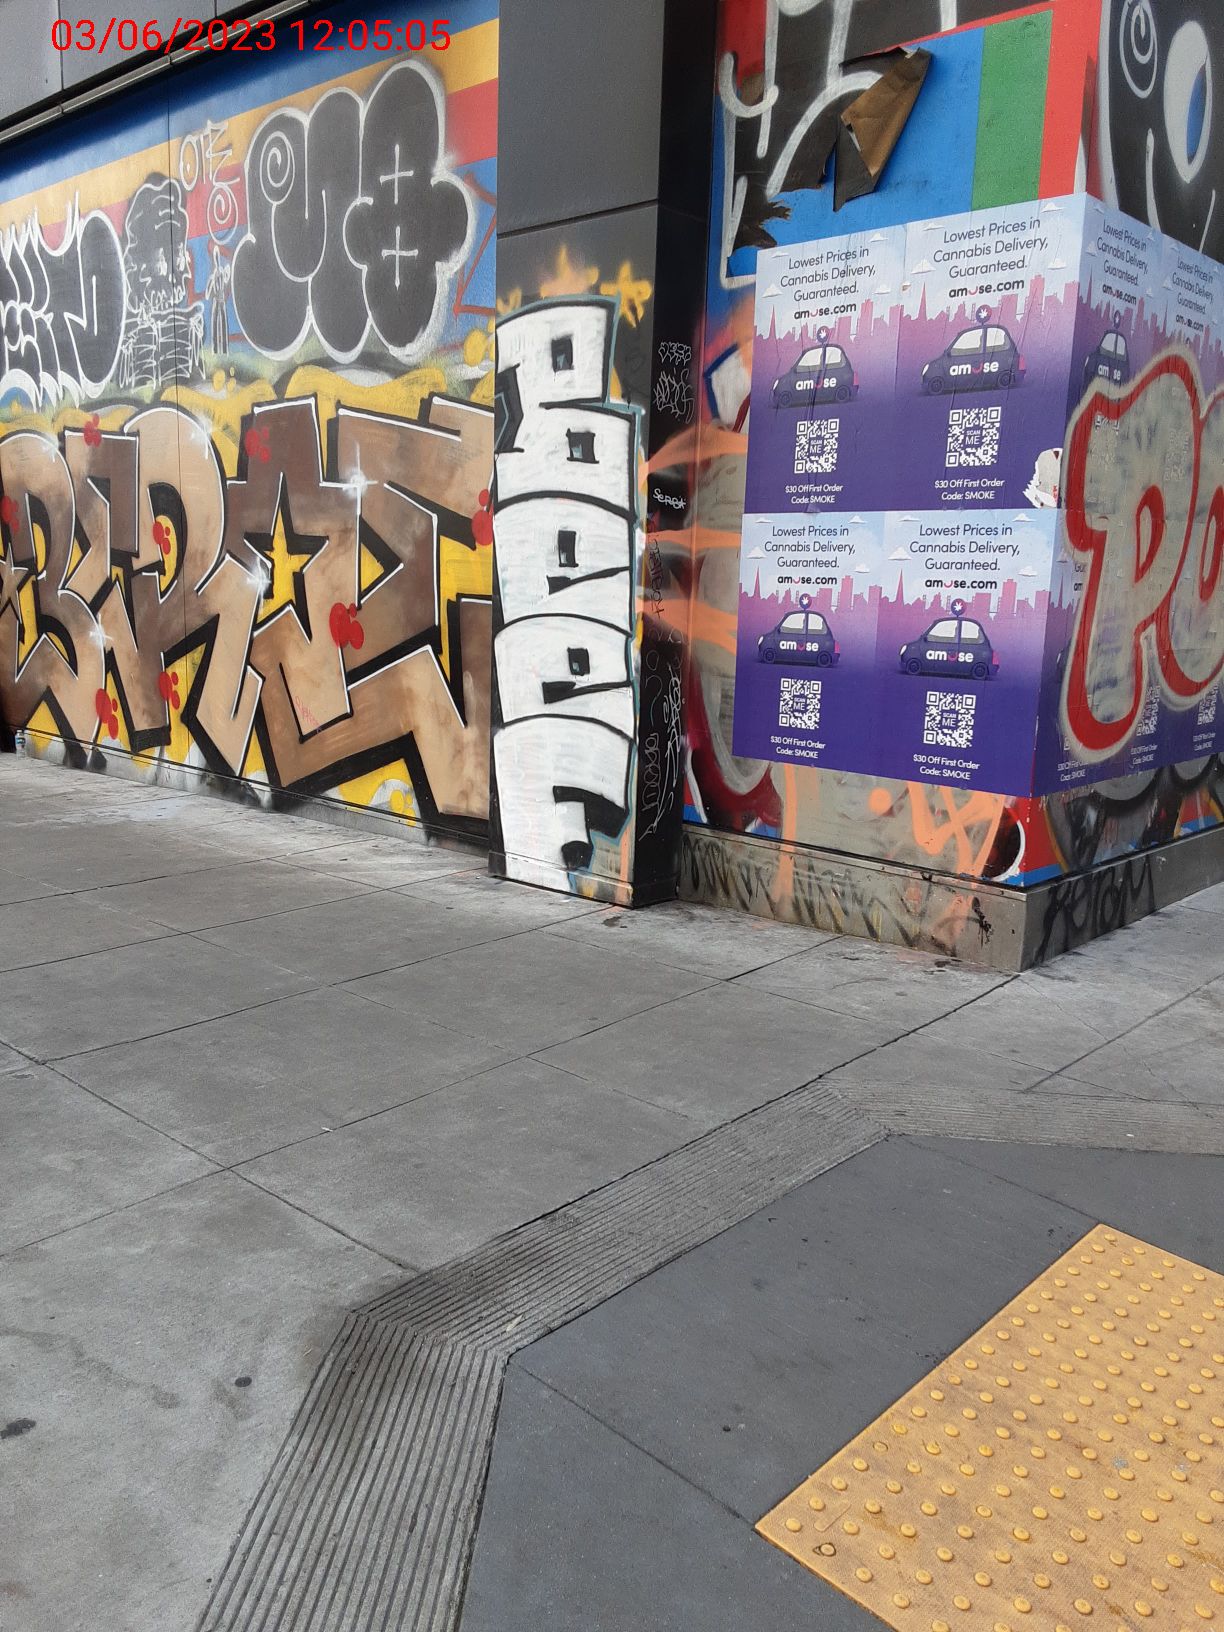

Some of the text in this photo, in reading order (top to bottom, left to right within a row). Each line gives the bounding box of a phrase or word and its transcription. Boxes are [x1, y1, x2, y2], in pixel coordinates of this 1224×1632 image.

[944, 217, 1040, 243] Lowest Prices in
[1104, 220, 1146, 251] Lowest Prices in
[934, 237, 1048, 262] Cannabis Delivery,
[1097, 237, 1125, 261] Cannabis
[789, 246, 869, 269] Lowest Prices in
[949, 255, 1027, 278] Guaranteed.
[781, 265, 875, 287] Cannabis Delivery,
[794, 281, 859, 301] Guaranteed.
[966, 436, 979, 445] ME
[810, 445, 821, 454] ME
[786, 484, 843, 493] $30 Off First Order
[935, 478, 1005, 488] $30 Off First Order
[810, 495, 835, 503] SMOKE
[965, 491, 995, 499] SMOKE
[773, 525, 848, 536] Lowest Prices in
[920, 524, 1012, 536] Lowest Prices in
[765, 541, 855, 555] Cannabis Delivery,
[910, 541, 1020, 557] Cannabis Delivery,
[777, 556, 839, 567] Guaranteed.
[925, 558, 1000, 570] Guaranteed.
[942, 719, 956, 727] ME
[782, 737, 793, 745] Off
[807, 740, 825, 749] Order
[795, 749, 818, 758] SMOKE
[913, 754, 980, 770] $30 Off First Order
[942, 769, 971, 780] SMOKE
